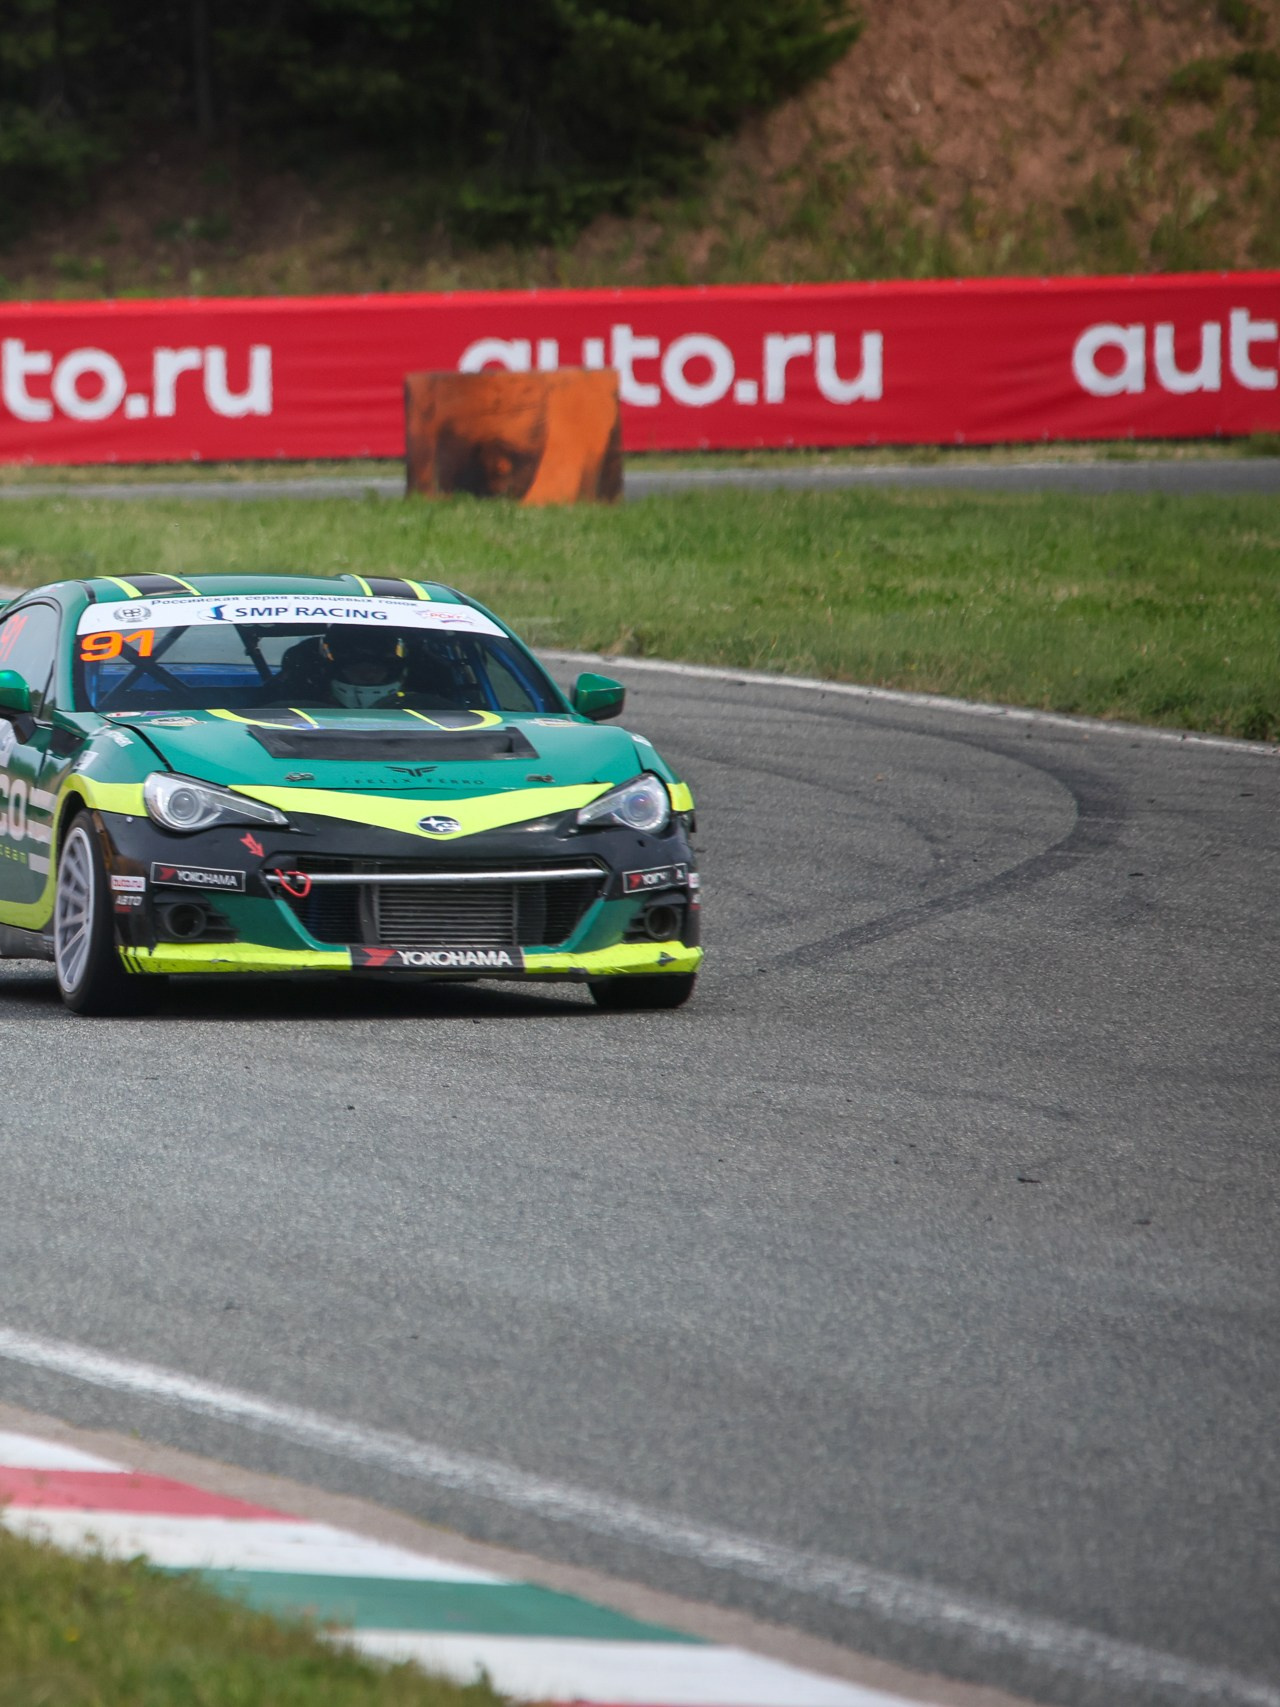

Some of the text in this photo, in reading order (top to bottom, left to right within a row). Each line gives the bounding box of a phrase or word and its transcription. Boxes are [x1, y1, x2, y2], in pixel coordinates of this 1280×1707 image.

[235, 607, 388, 620] SMP RACING
[80, 629, 155, 661] 91
[176, 870, 238, 887] YOKOHAMA
[397, 950, 513, 966] YOKOHAMA
